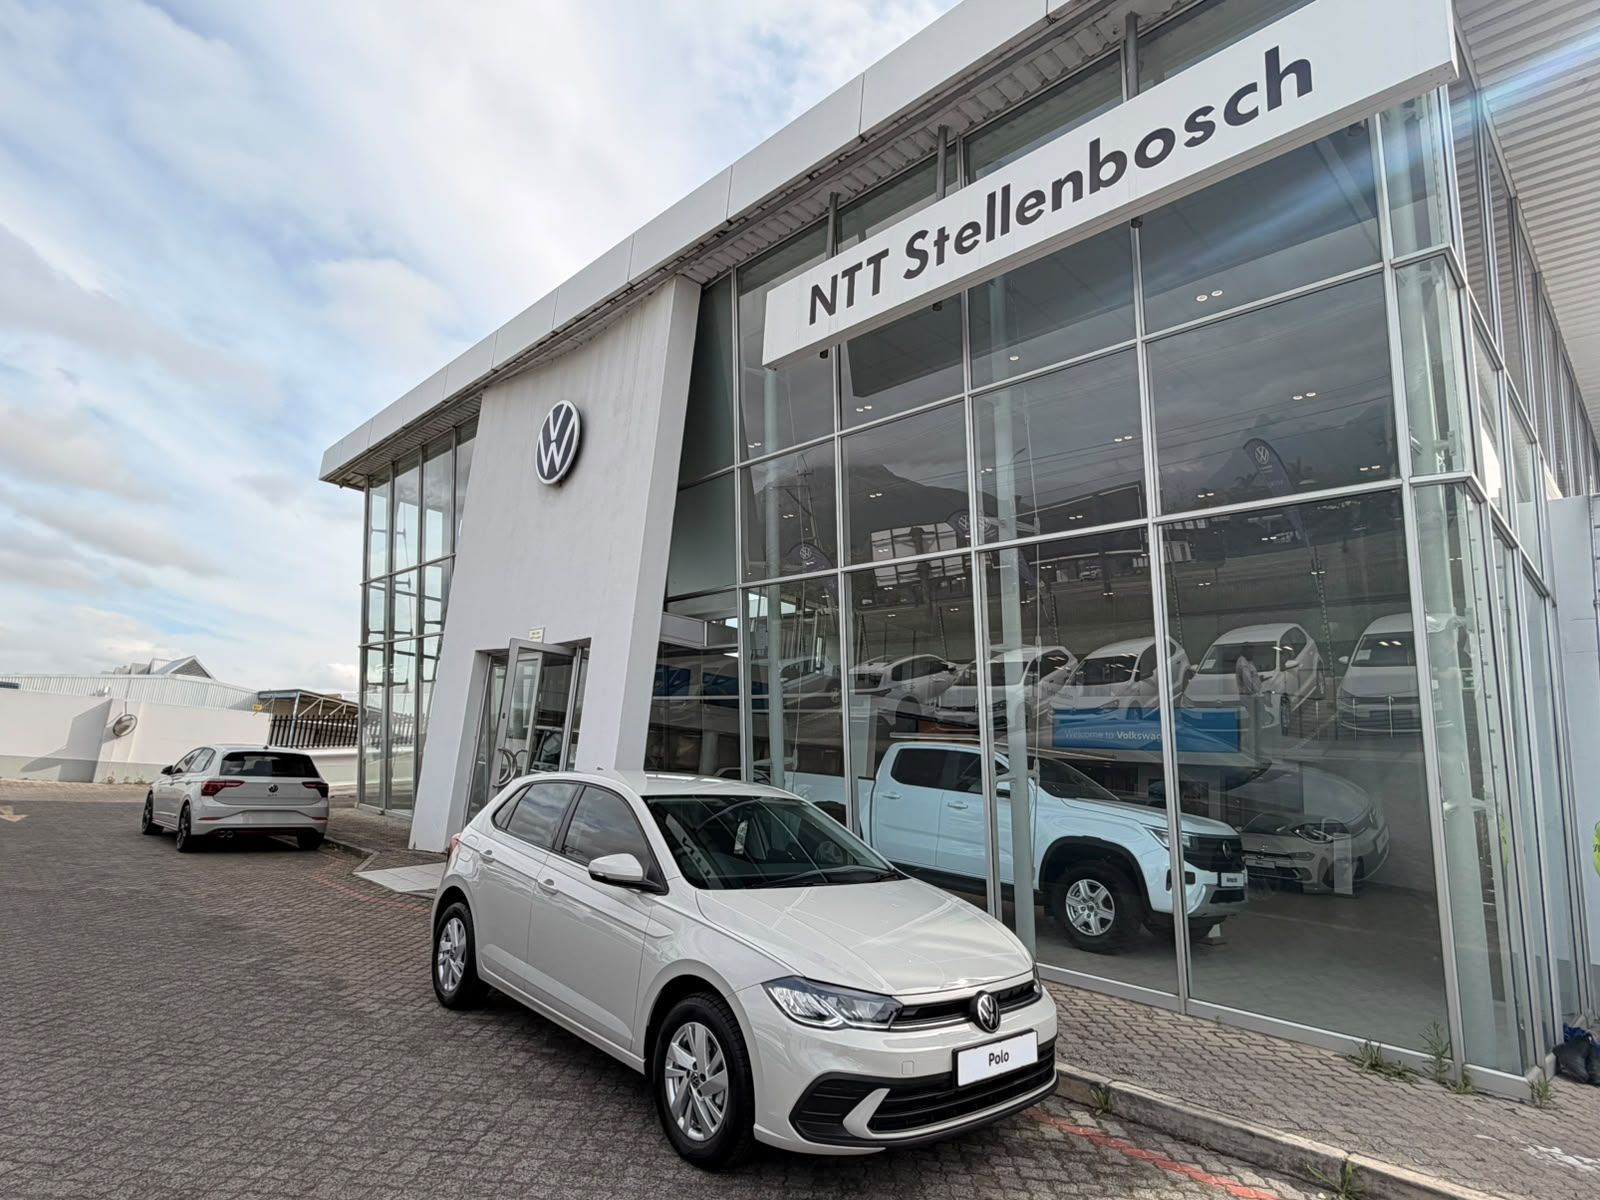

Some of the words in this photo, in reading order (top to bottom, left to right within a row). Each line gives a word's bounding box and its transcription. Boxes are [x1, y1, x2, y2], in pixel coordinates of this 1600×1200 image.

[810, 249, 890, 325] NTT
[904, 46, 1313, 280] Stellenbosch
[988, 1049, 1010, 1067] Polo
